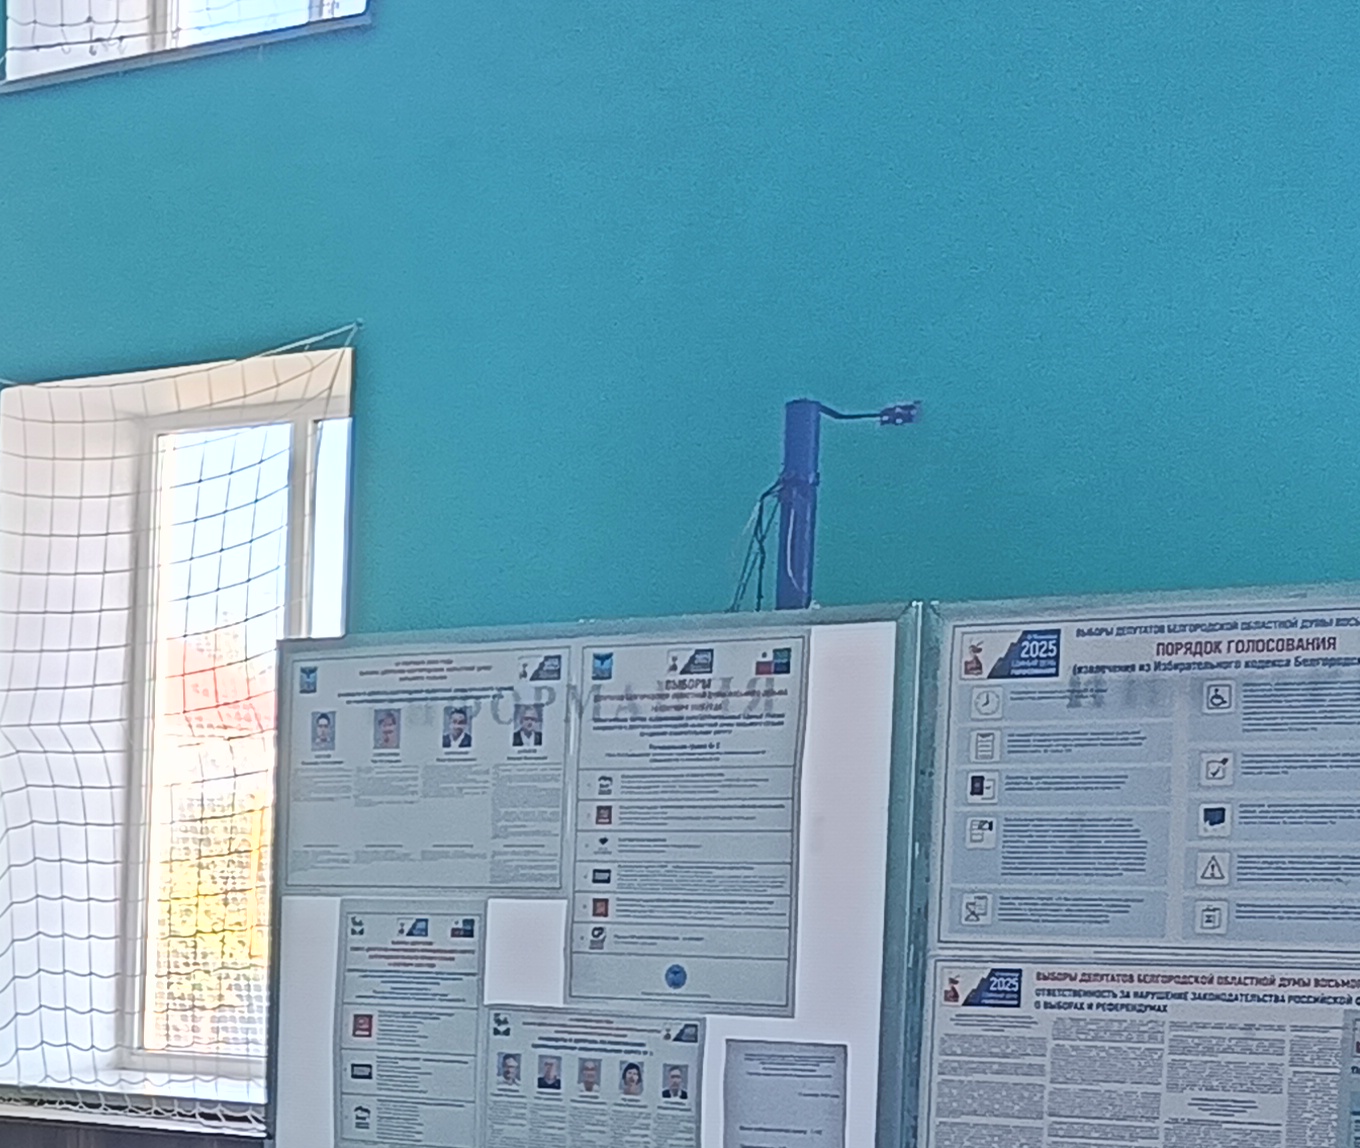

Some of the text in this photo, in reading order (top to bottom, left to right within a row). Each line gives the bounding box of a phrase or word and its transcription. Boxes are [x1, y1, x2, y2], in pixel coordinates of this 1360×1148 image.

[1020, 640, 1057, 658] 2025
[1156, 637, 1337, 657] ПОРЯДОК ГОЛОСОВАНИЯ
[1139, 663, 1151, 672] из
[989, 976, 1020, 992] 2025
[1036, 972, 1078, 981] ВЫБОРЫ
[1079, 973, 1134, 983] ДЕПУТАТОВ
[1137, 974, 1214, 986] БЕЛГОРОДСКОЙ
[1216, 975, 1276, 986] ОБЛАСТНОЙ
[1288, 994, 1352, 1005] РОССИЙСКОЙ
